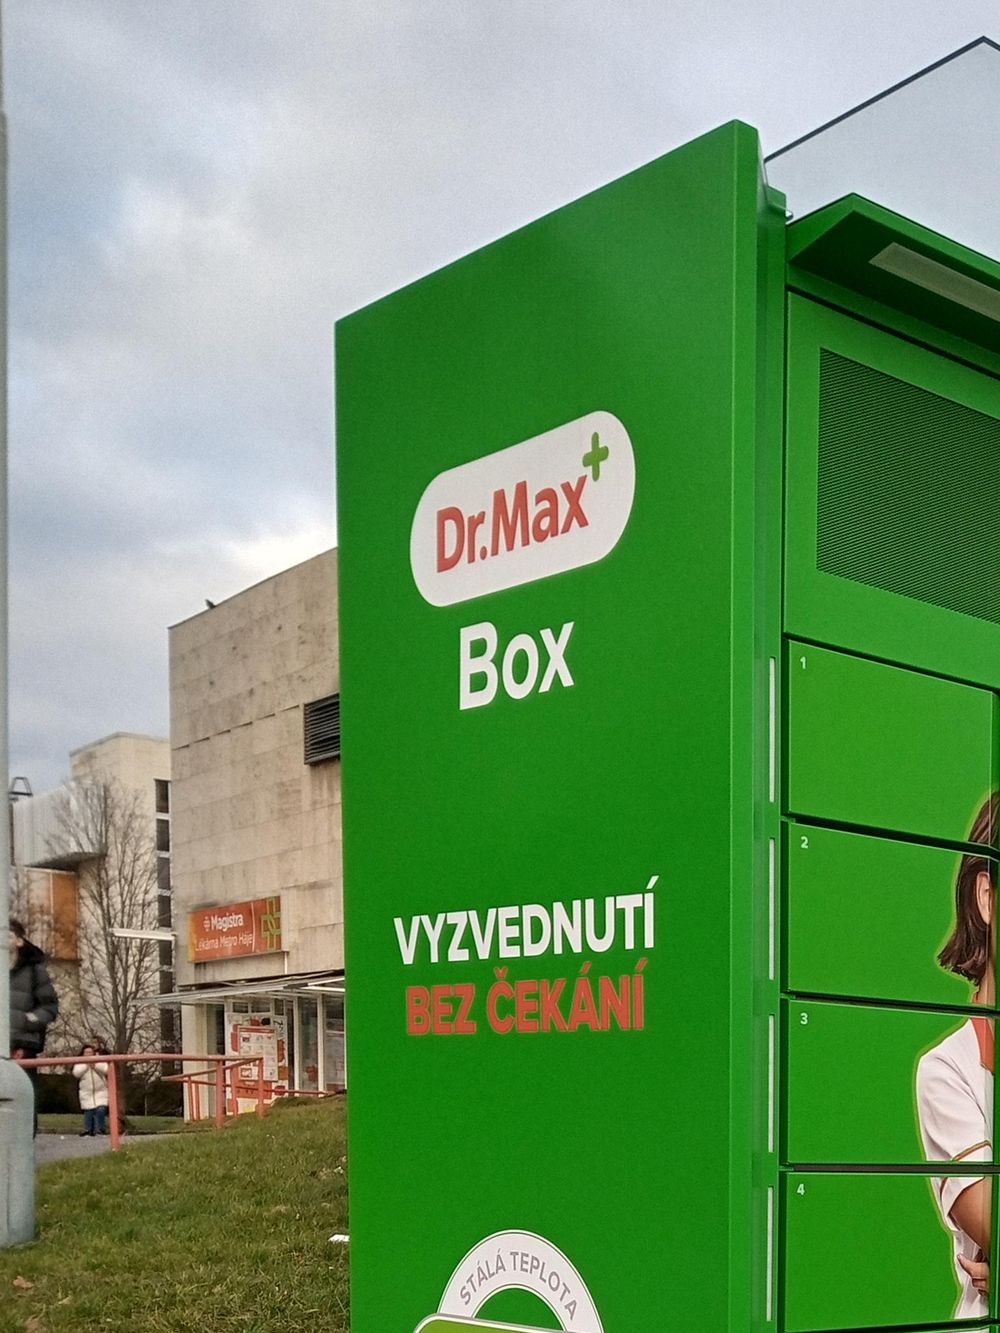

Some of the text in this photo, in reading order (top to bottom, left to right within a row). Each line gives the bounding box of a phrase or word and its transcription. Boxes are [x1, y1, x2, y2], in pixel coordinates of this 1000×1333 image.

[459, 621, 575, 710] Box
[798, 655, 807, 670] 1
[799, 835, 809, 849] 2
[211, 912, 244, 931] Magistra
[394, 875, 659, 965] VYZVEDNUTÍ
[406, 957, 648, 1036] BEZ ČEKÁNÍ
[799, 1011, 808, 1026] 3
[796, 1183, 806, 1197] 4
[459, 1248, 578, 1320] STÁLÁ TEPLOTA
